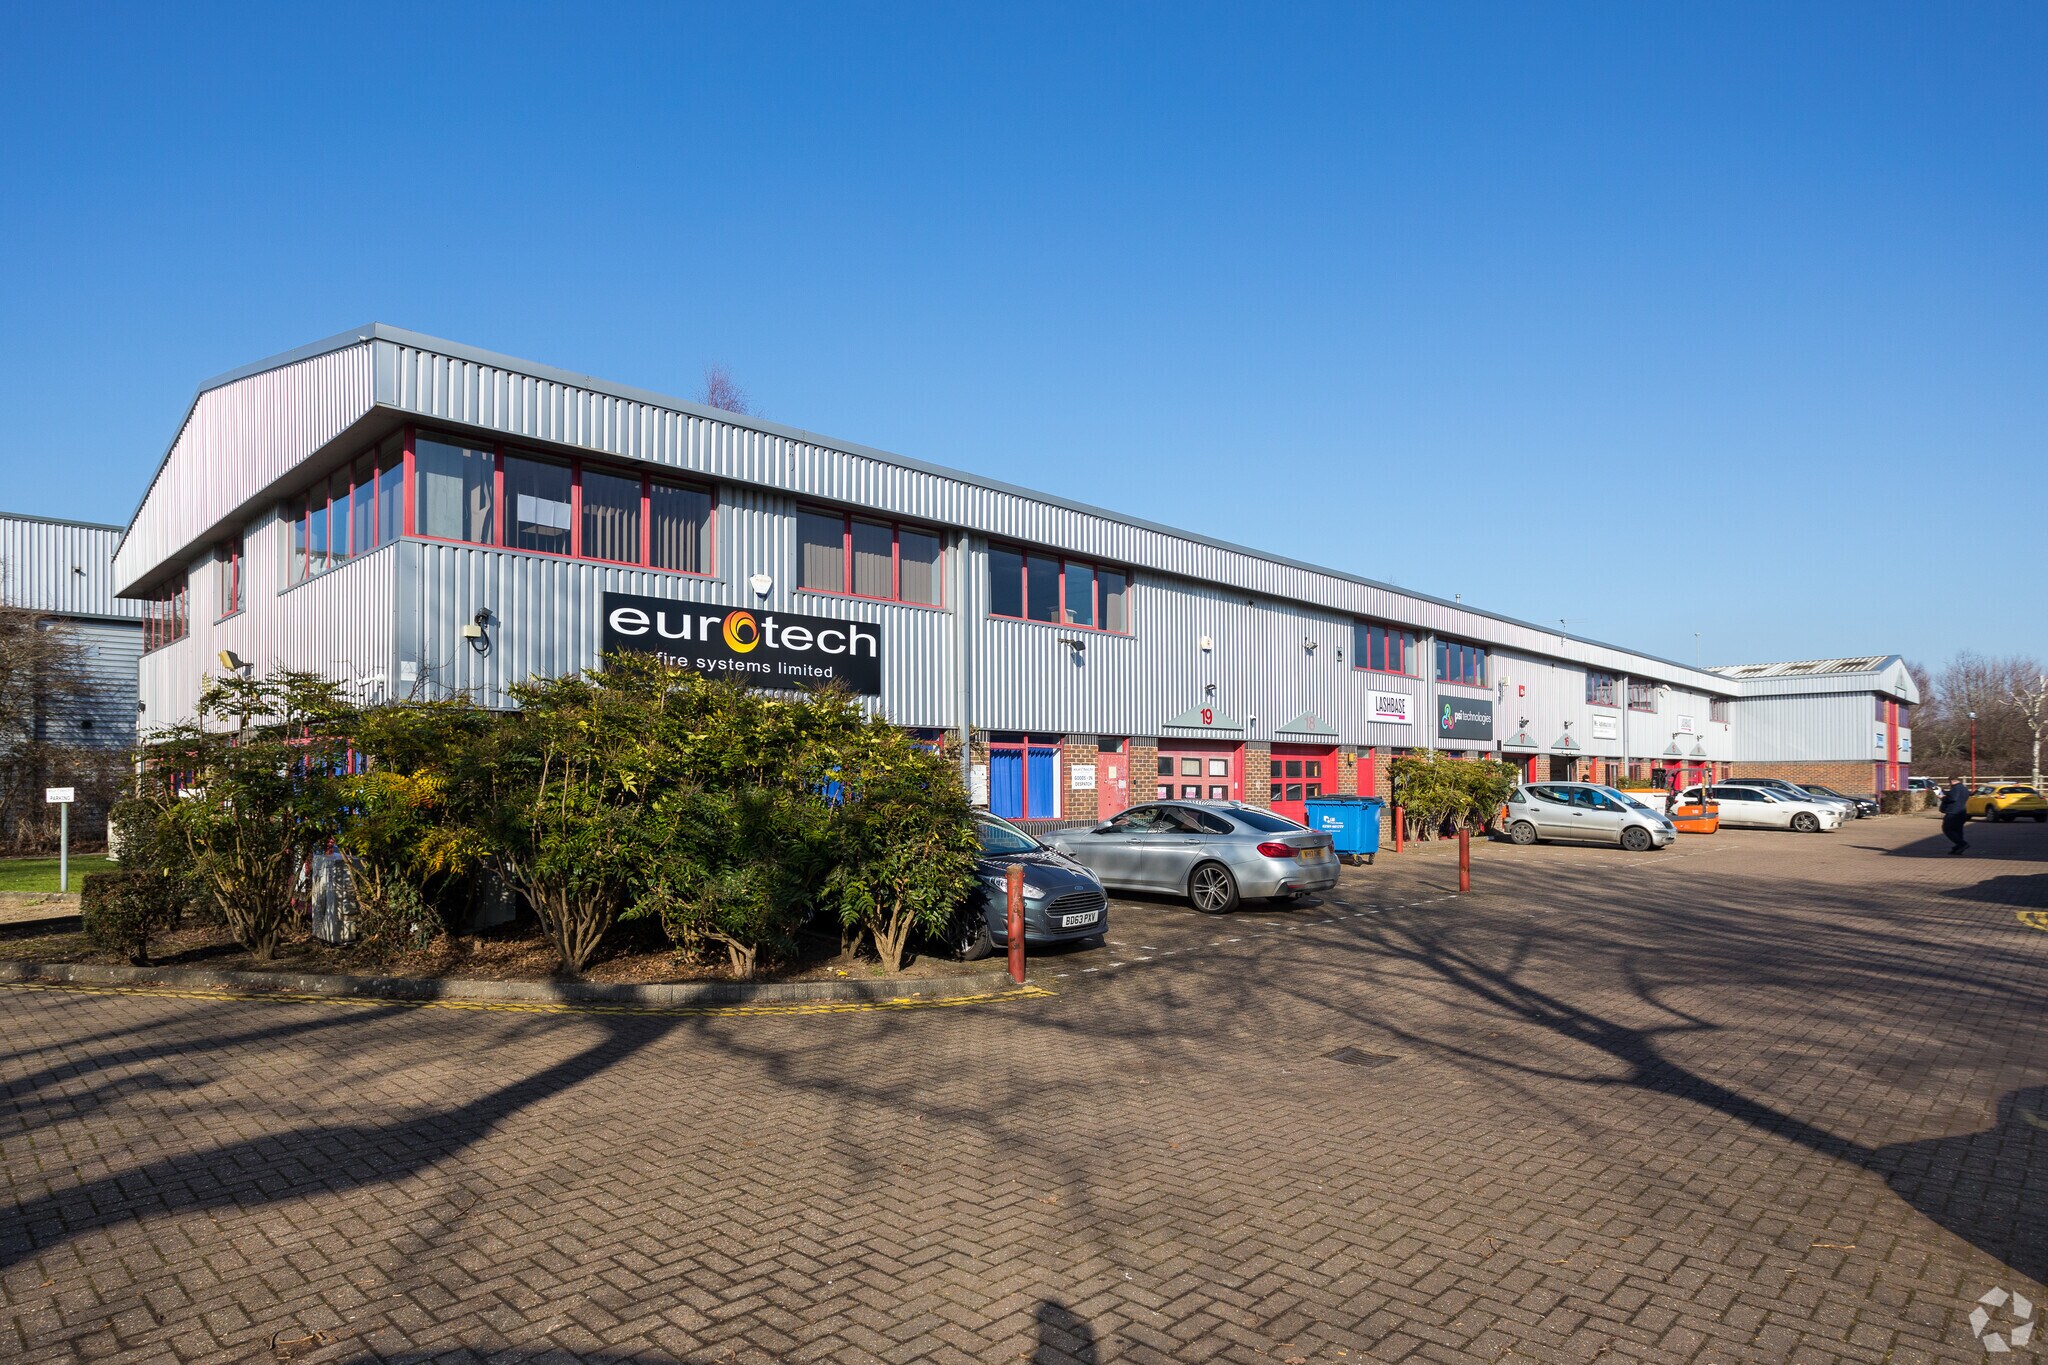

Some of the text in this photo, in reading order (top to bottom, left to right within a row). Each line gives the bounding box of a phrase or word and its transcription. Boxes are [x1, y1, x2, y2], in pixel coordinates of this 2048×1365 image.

[609, 607, 877, 658] eurotech
[656, 651, 833, 679] fire systems limited
[1375, 695, 1406, 714] LASHBASE
[1200, 708, 1213, 725] 19
[1304, 715, 1316, 732] 18
[1454, 709, 1492, 726] psi technologies
[1519, 733, 1526, 744] 17
[1065, 912, 1096, 926] BD63 PXV
